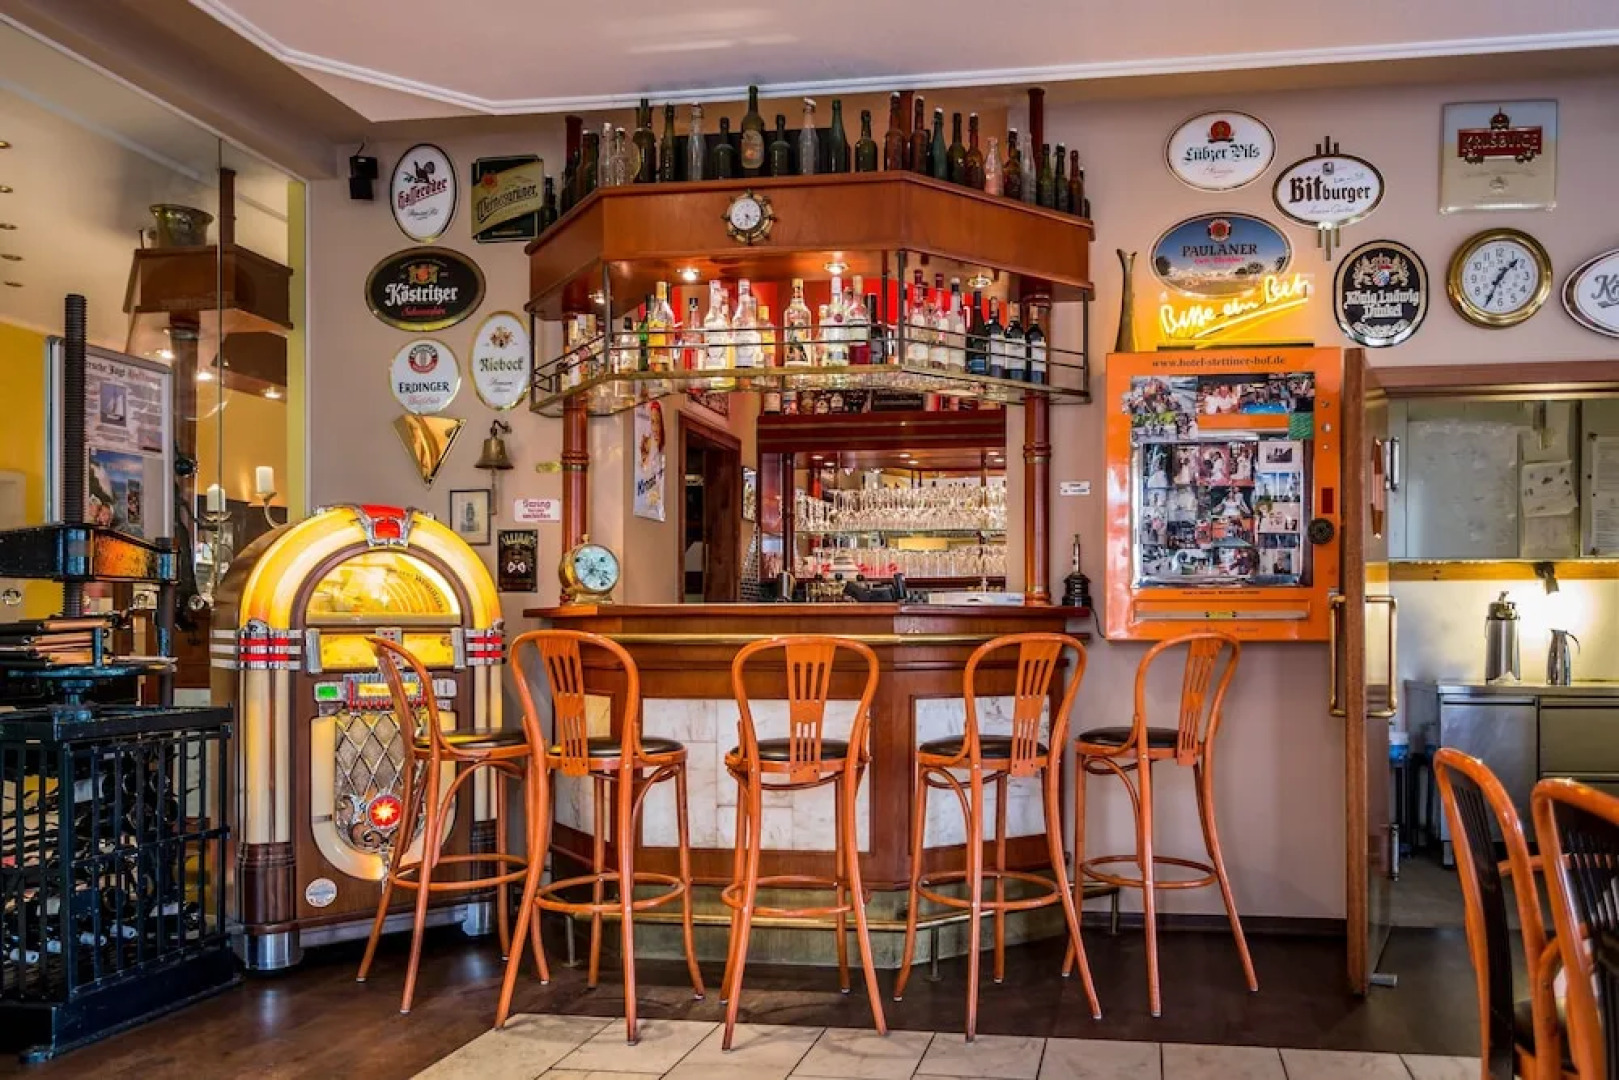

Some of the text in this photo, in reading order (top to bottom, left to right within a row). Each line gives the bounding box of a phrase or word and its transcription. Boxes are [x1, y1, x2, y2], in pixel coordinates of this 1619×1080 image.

[1183, 144, 1260, 165] Lübzer Pils
[1289, 175, 1371, 204] Bitburger
[1182, 243, 1258, 257] PAULANER
[384, 283, 459, 306] Köstritzer
[1152, 355, 1286, 367] www.hotel-stettiner-hof.de
[399, 381, 451, 394] ERDINGER
